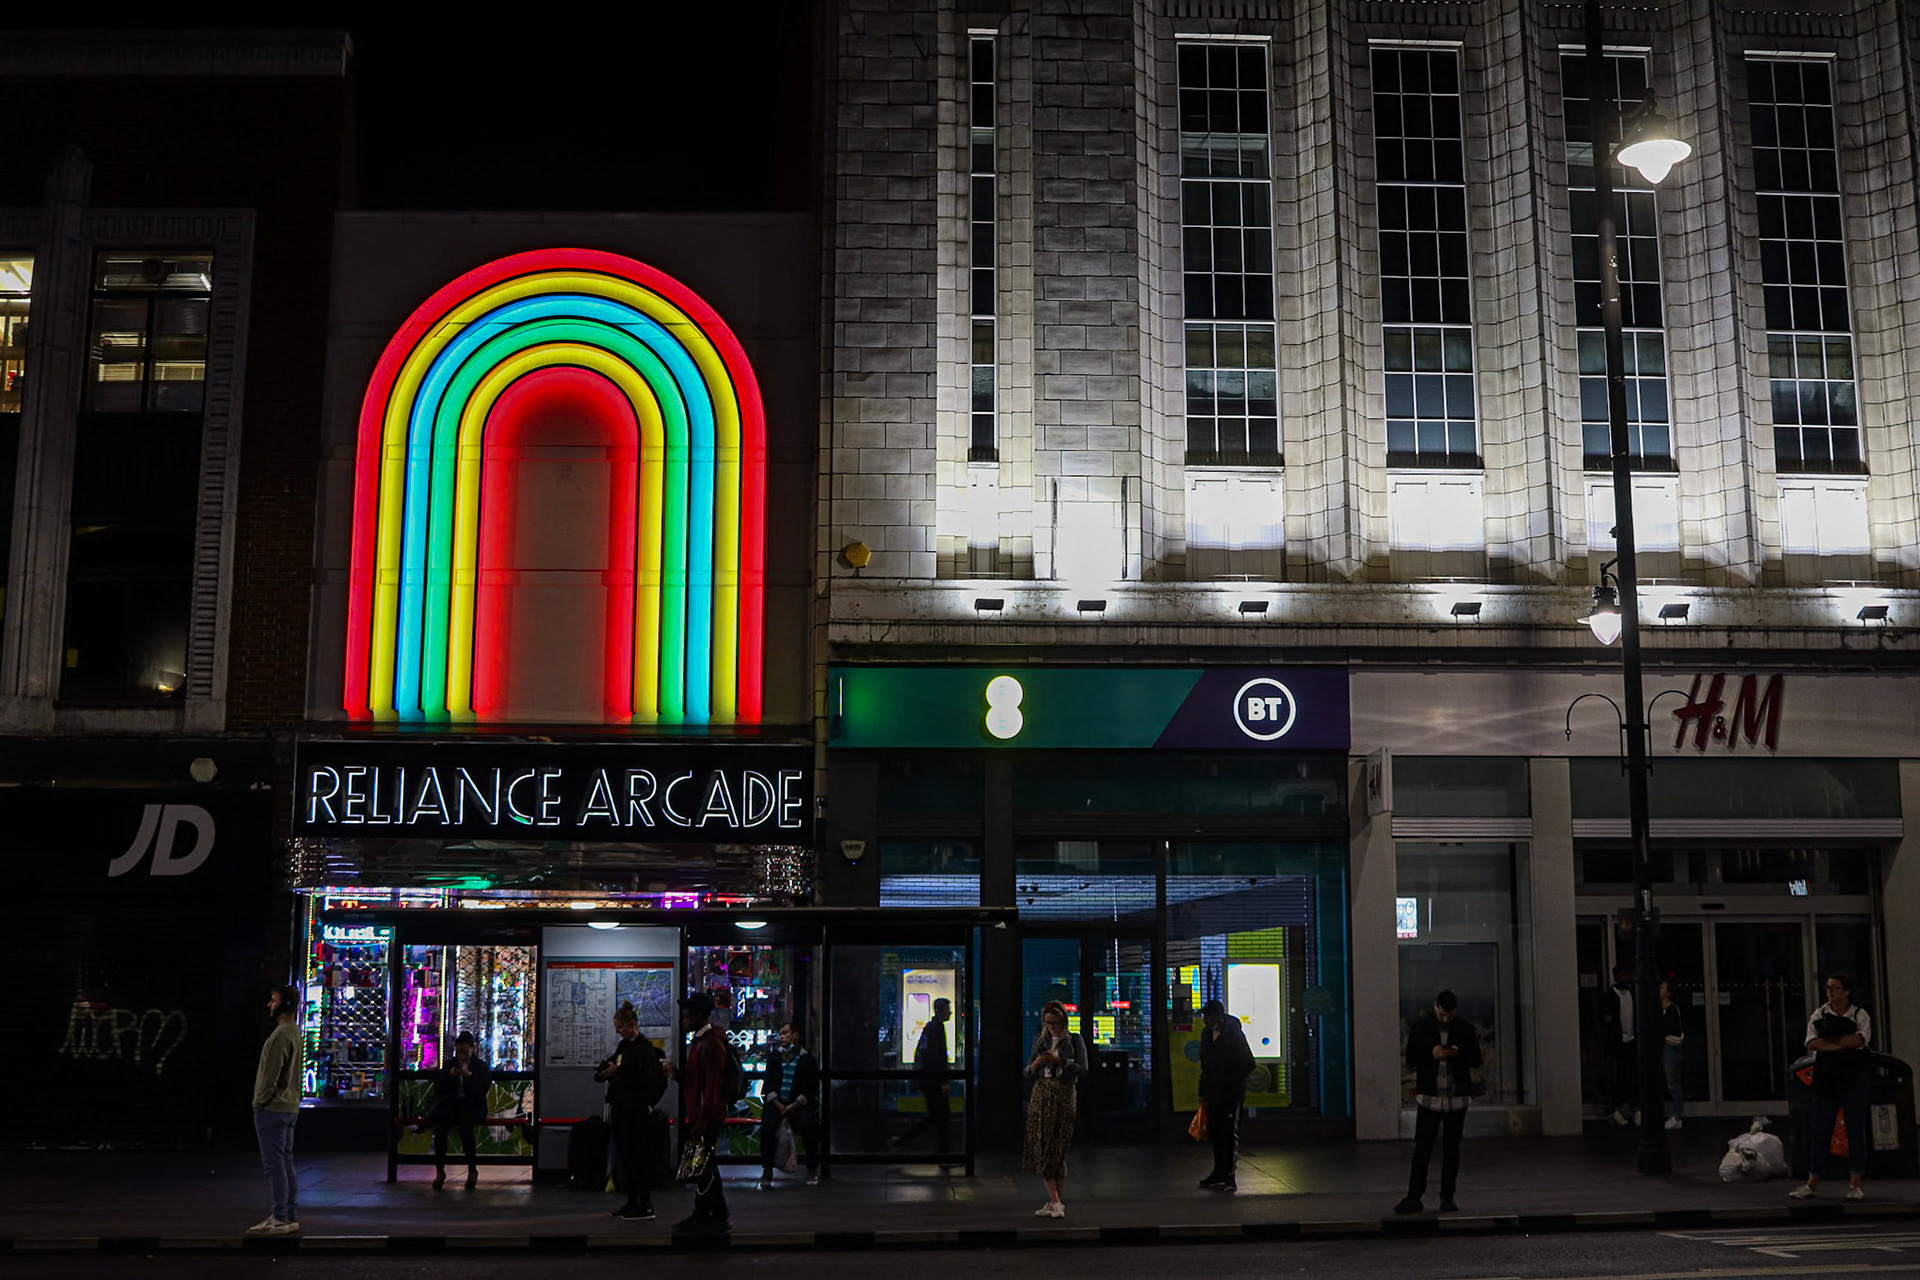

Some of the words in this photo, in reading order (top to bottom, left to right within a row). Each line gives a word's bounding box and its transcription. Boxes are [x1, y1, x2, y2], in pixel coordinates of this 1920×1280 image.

[1247, 696, 1282, 722] BT
[1672, 672, 1784, 753] H&M
[305, 765, 563, 826] RELIANCE
[576, 767, 804, 829] ARCADE
[107, 803, 217, 877] JD
